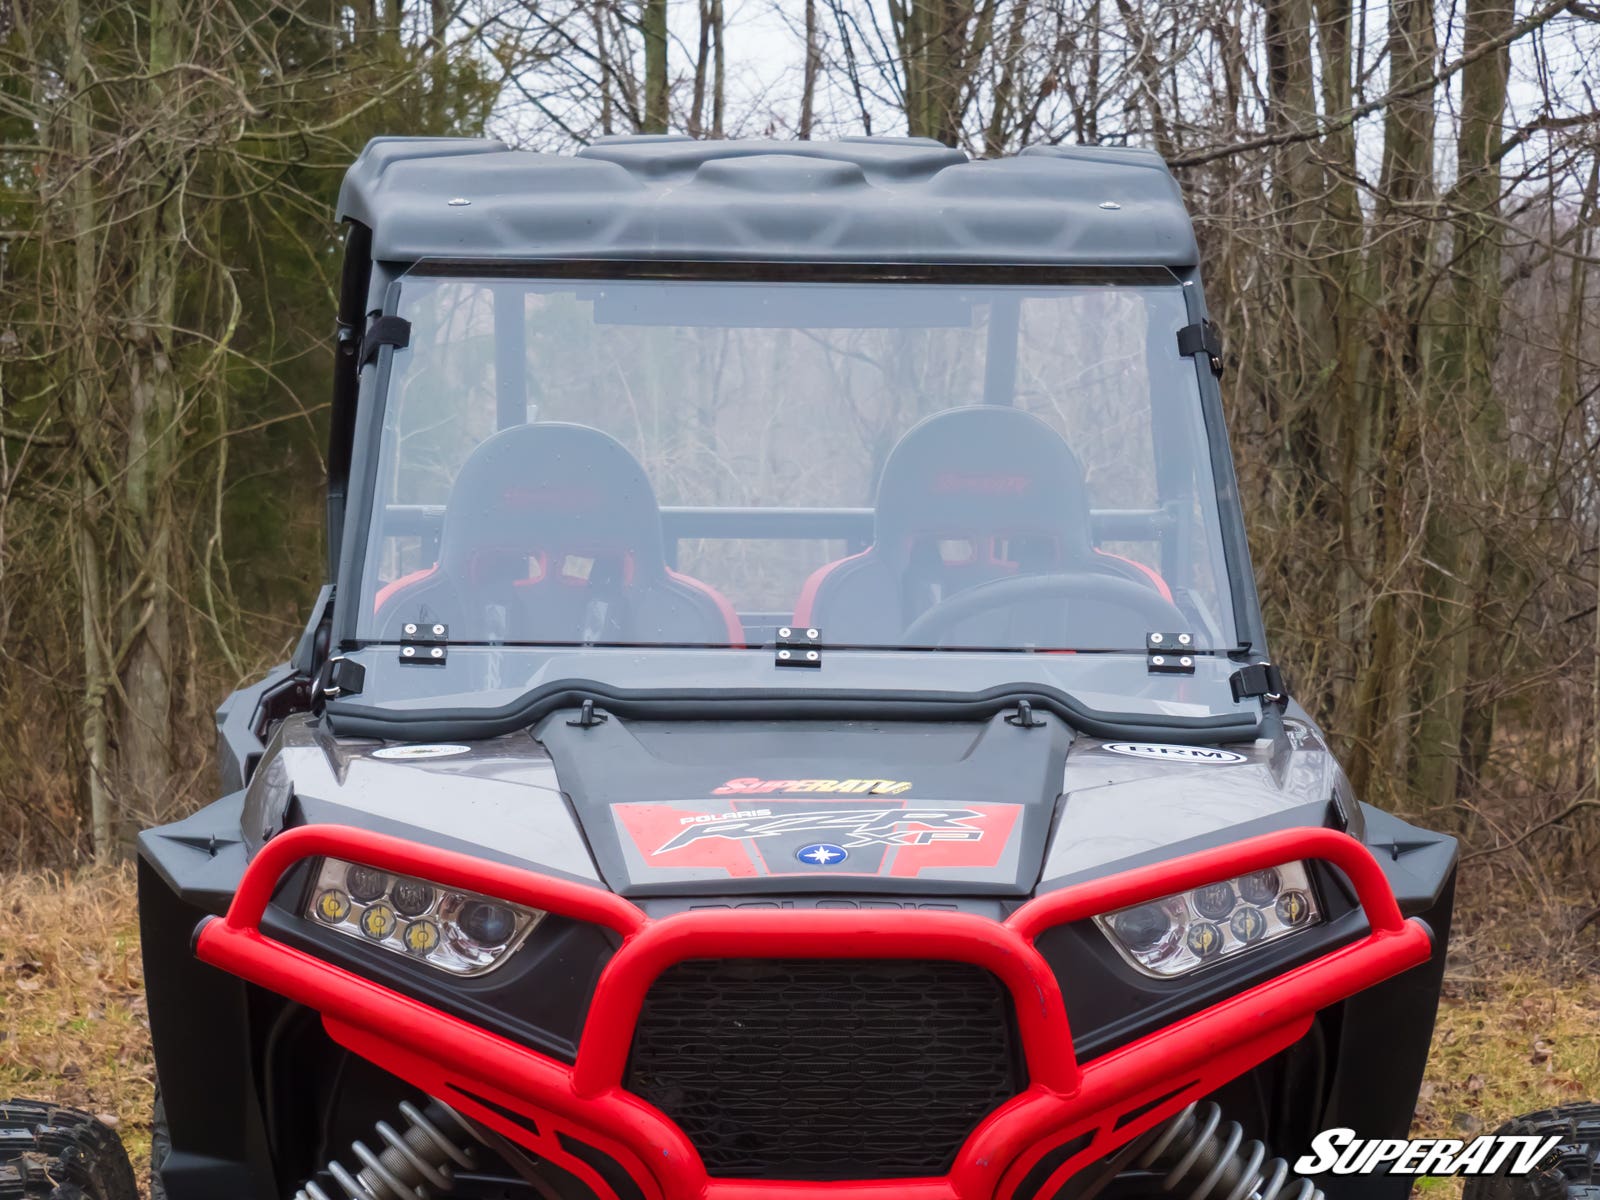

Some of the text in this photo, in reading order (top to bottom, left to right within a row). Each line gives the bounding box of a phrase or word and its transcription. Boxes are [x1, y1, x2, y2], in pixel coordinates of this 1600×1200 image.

[1128, 745, 1224, 759] BRM
[712, 777, 896, 795] SUPERATV
[679, 808, 772, 826] POLARIS
[651, 809, 986, 855] RZR
[841, 830, 984, 848] XP
